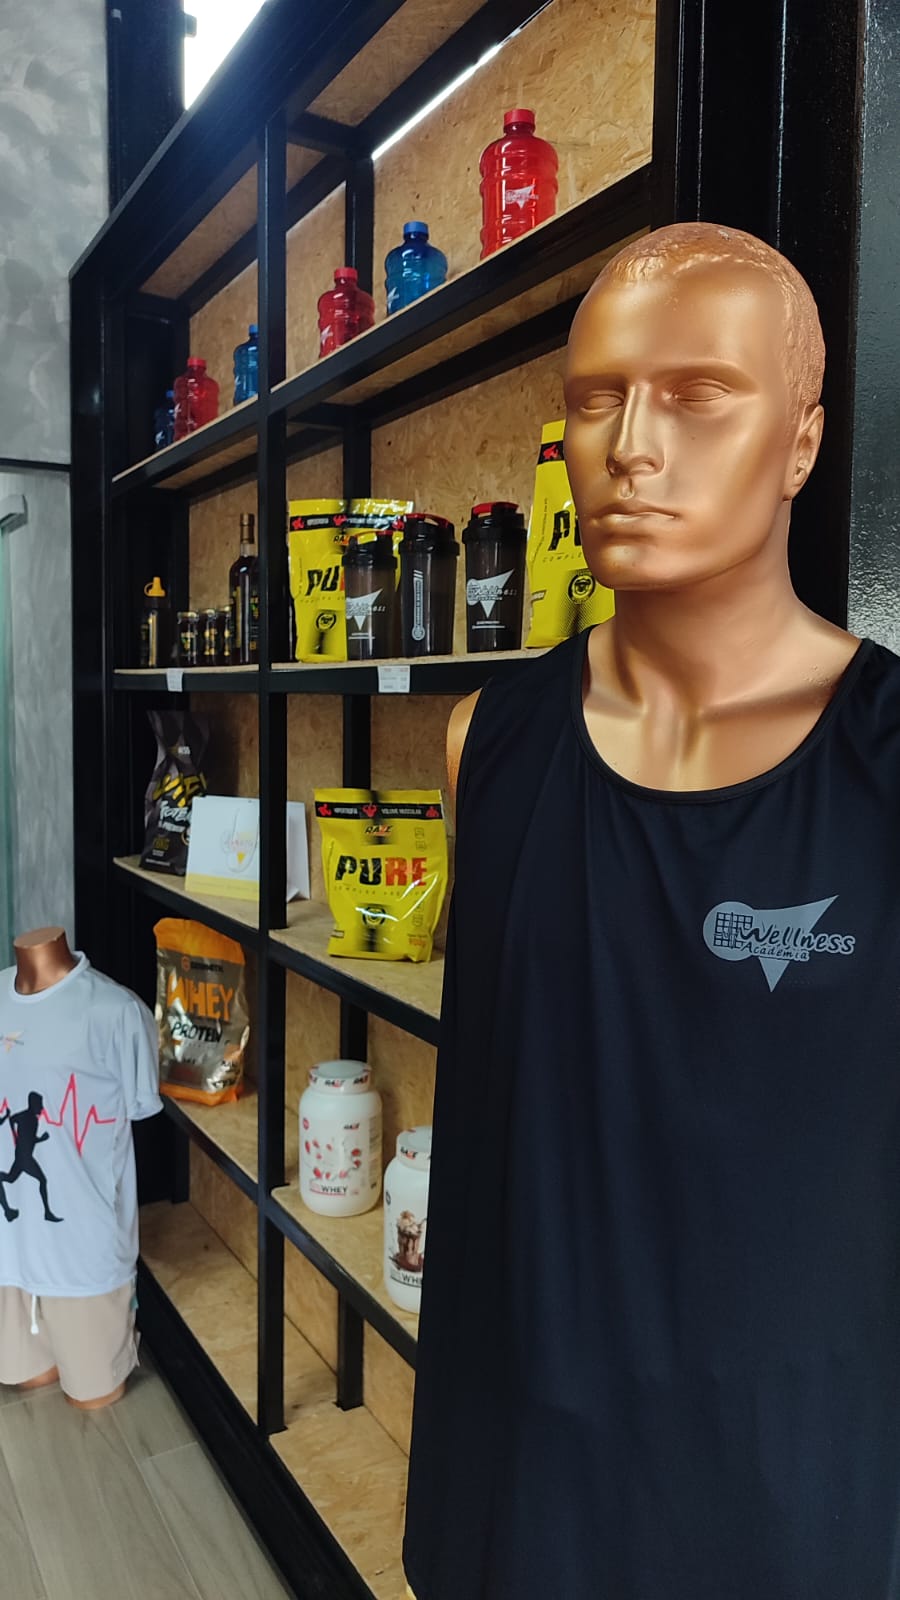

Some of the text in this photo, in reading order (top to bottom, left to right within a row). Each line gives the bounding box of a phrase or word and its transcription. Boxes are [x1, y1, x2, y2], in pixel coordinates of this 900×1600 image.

[305, 565, 345, 596] PU
[335, 855, 428, 886] PURE
[738, 923, 856, 954] Wellness
[167, 974, 234, 1021] WHEY
[171, 1021, 223, 1044] PROTEIN
[321, 1184, 348, 1194] WHEY
